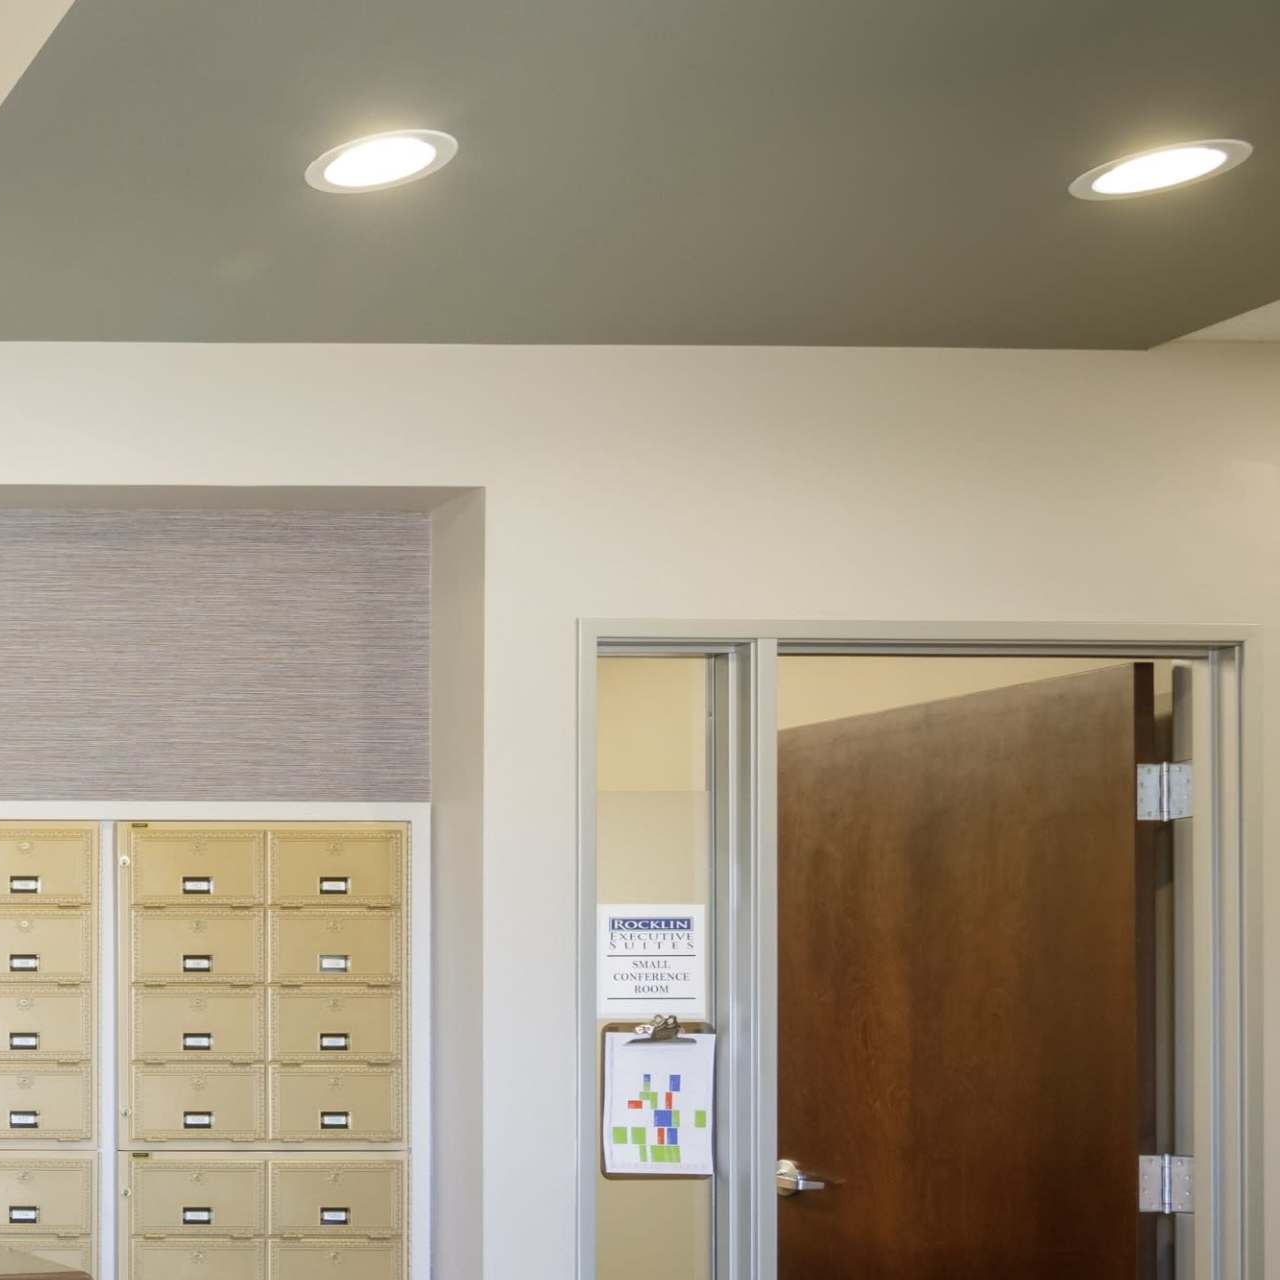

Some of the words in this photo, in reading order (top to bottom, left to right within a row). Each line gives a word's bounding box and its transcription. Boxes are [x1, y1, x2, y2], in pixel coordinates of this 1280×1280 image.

[614, 920, 688, 930] ROCKLIN
[610, 932, 694, 941] EXECUTIVE
[609, 941, 694, 950] SUITES
[632, 960, 671, 969] SMALL
[613, 972, 689, 981] CONFERENCE
[634, 985, 670, 993] ROOM
